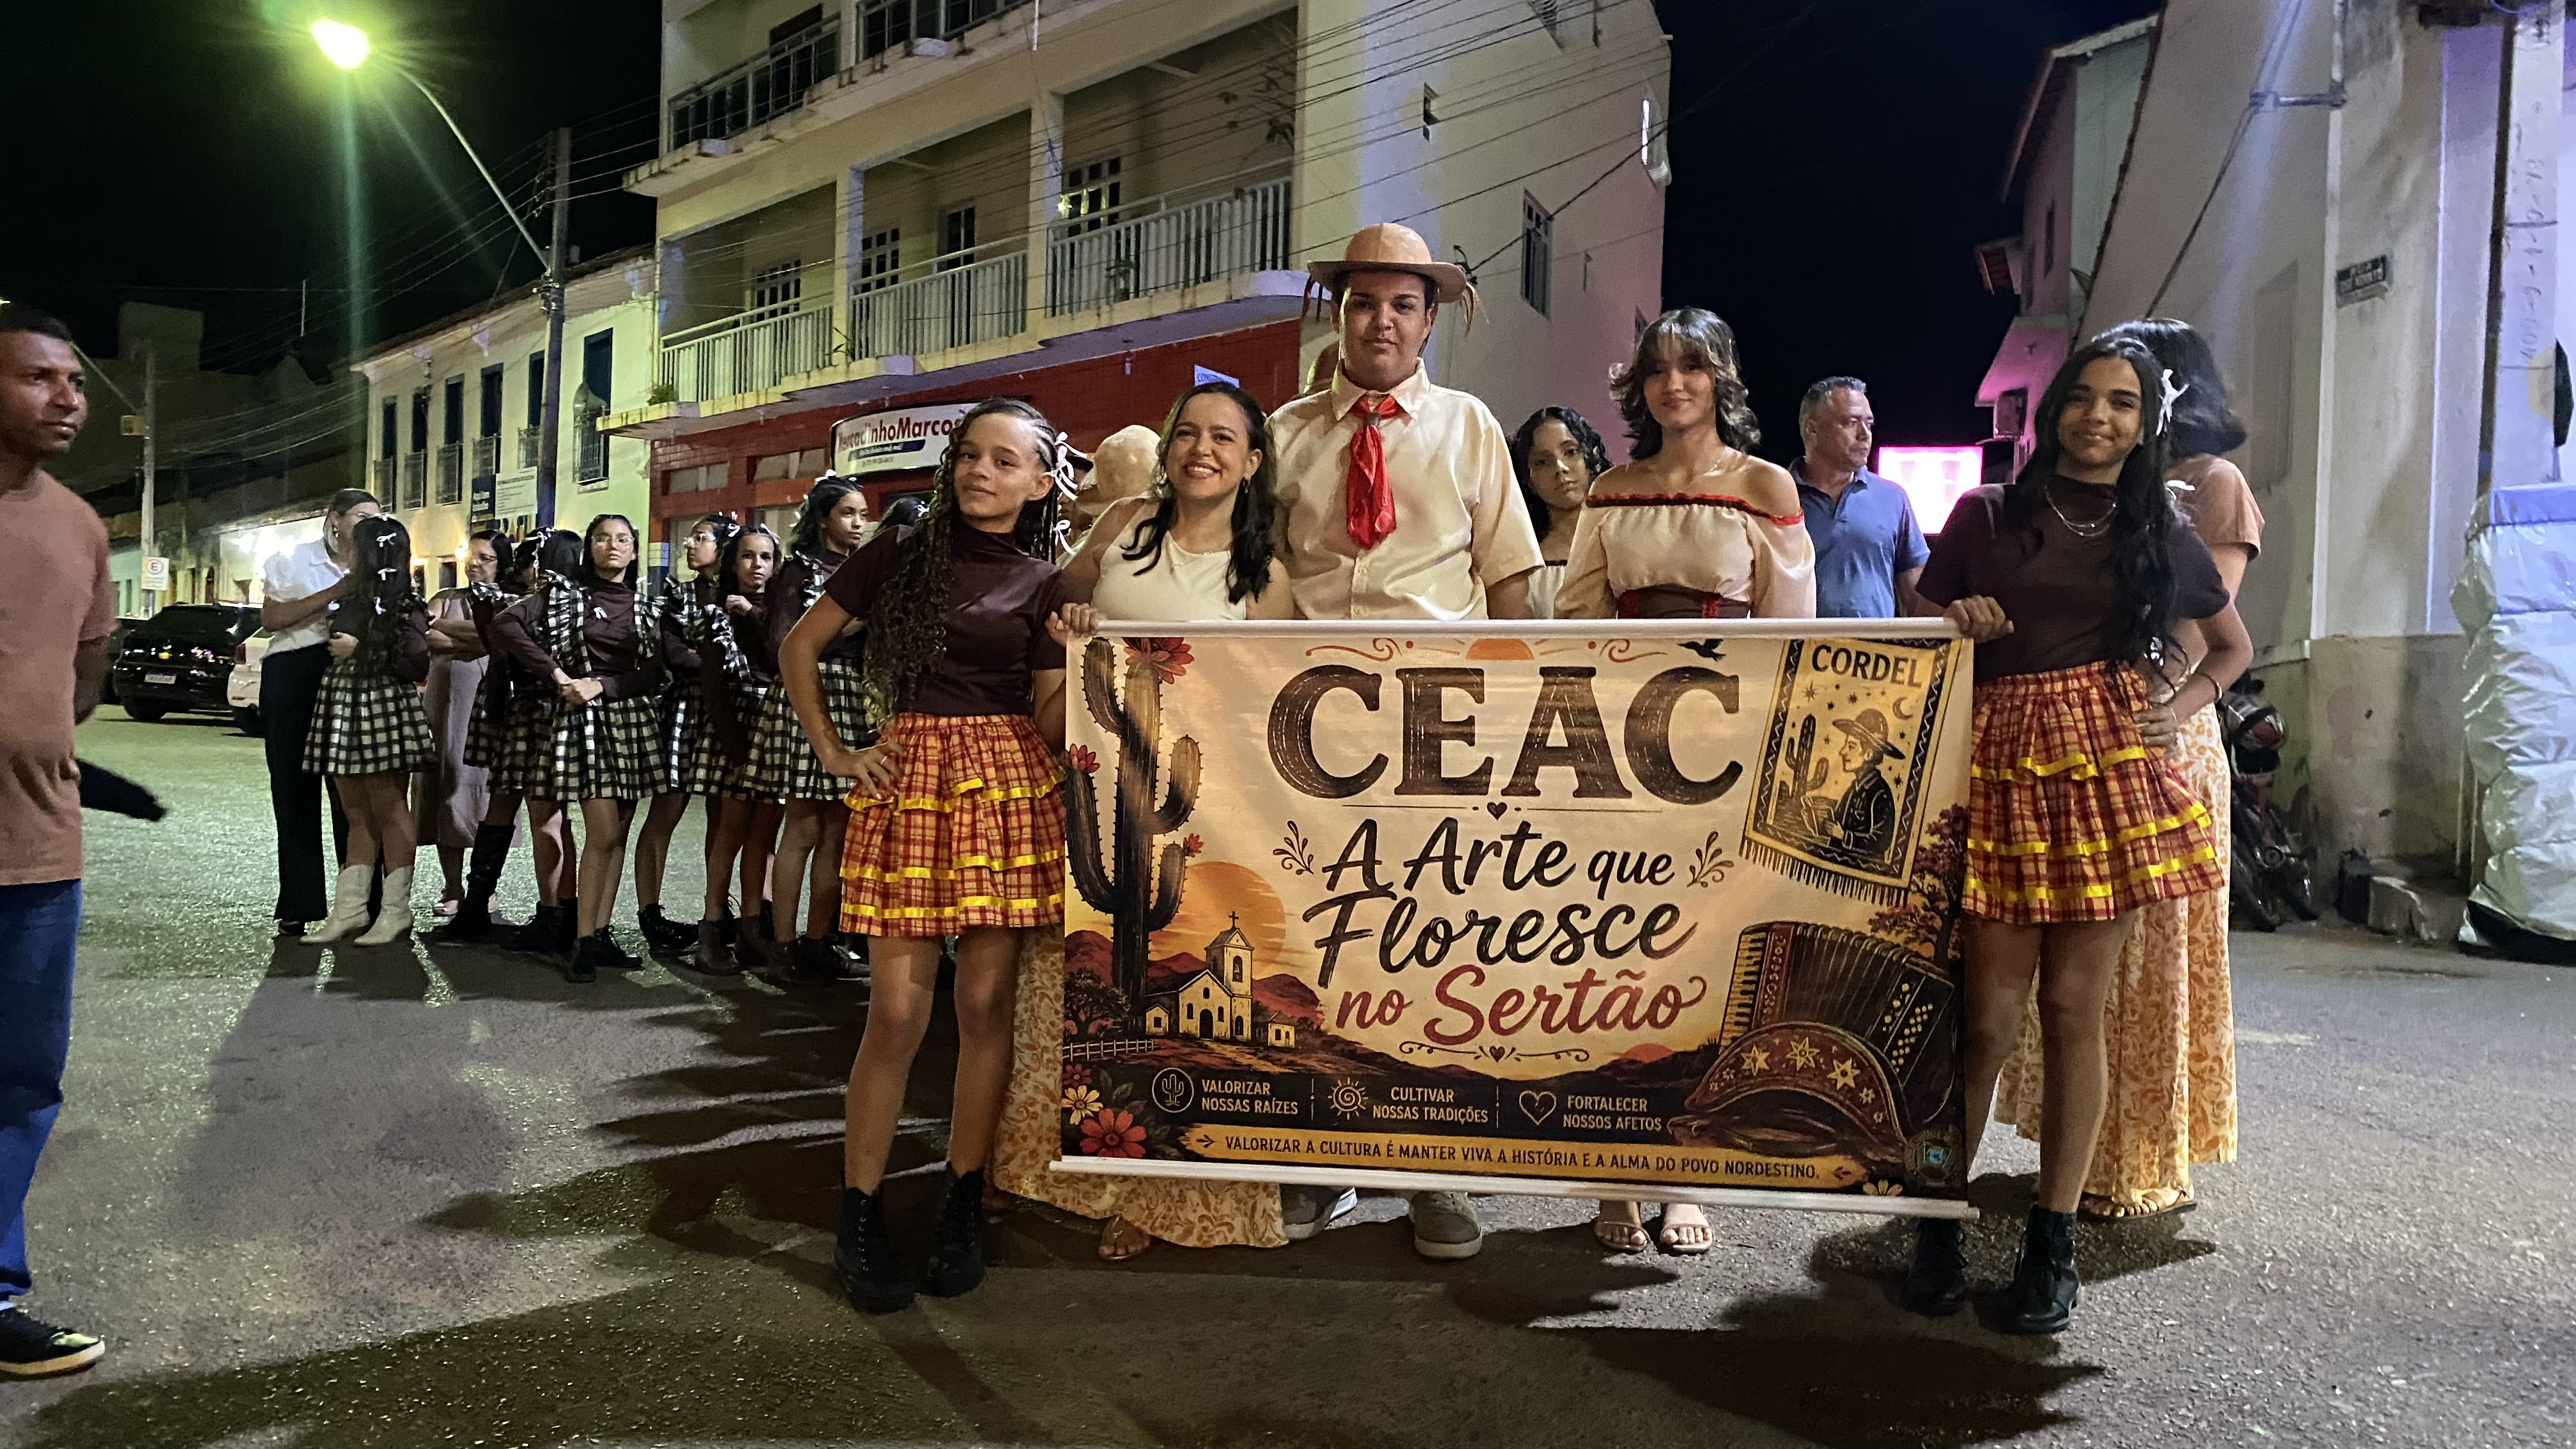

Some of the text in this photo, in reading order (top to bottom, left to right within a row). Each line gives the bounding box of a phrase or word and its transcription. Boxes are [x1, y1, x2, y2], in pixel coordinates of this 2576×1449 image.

[1812, 644, 1922, 688] CORDEL
[1268, 664, 1744, 805] CEAC
[1321, 816, 1676, 900] A Arte que
[1301, 889, 1699, 989] Floresce
[1336, 964, 1707, 1046] no Sertão
[1201, 1078, 1271, 1096] VALORIZAR
[1390, 1086, 1454, 1103] CULTIVAR
[1201, 1097, 1299, 1115] NOSSAS RAÍZES
[1373, 1105, 1489, 1125] NOSSAS TRADIÇÕES
[1567, 1094, 1648, 1112] FORTALECER
[1563, 1114, 1662, 1132] NOSSOS AFETOS
[1225, 1136, 1819, 1179] VALORIZAR A CULTURA É MANTER VIVA A HISTÓRIA E A ALMA DO POVO NORDESTINO.
